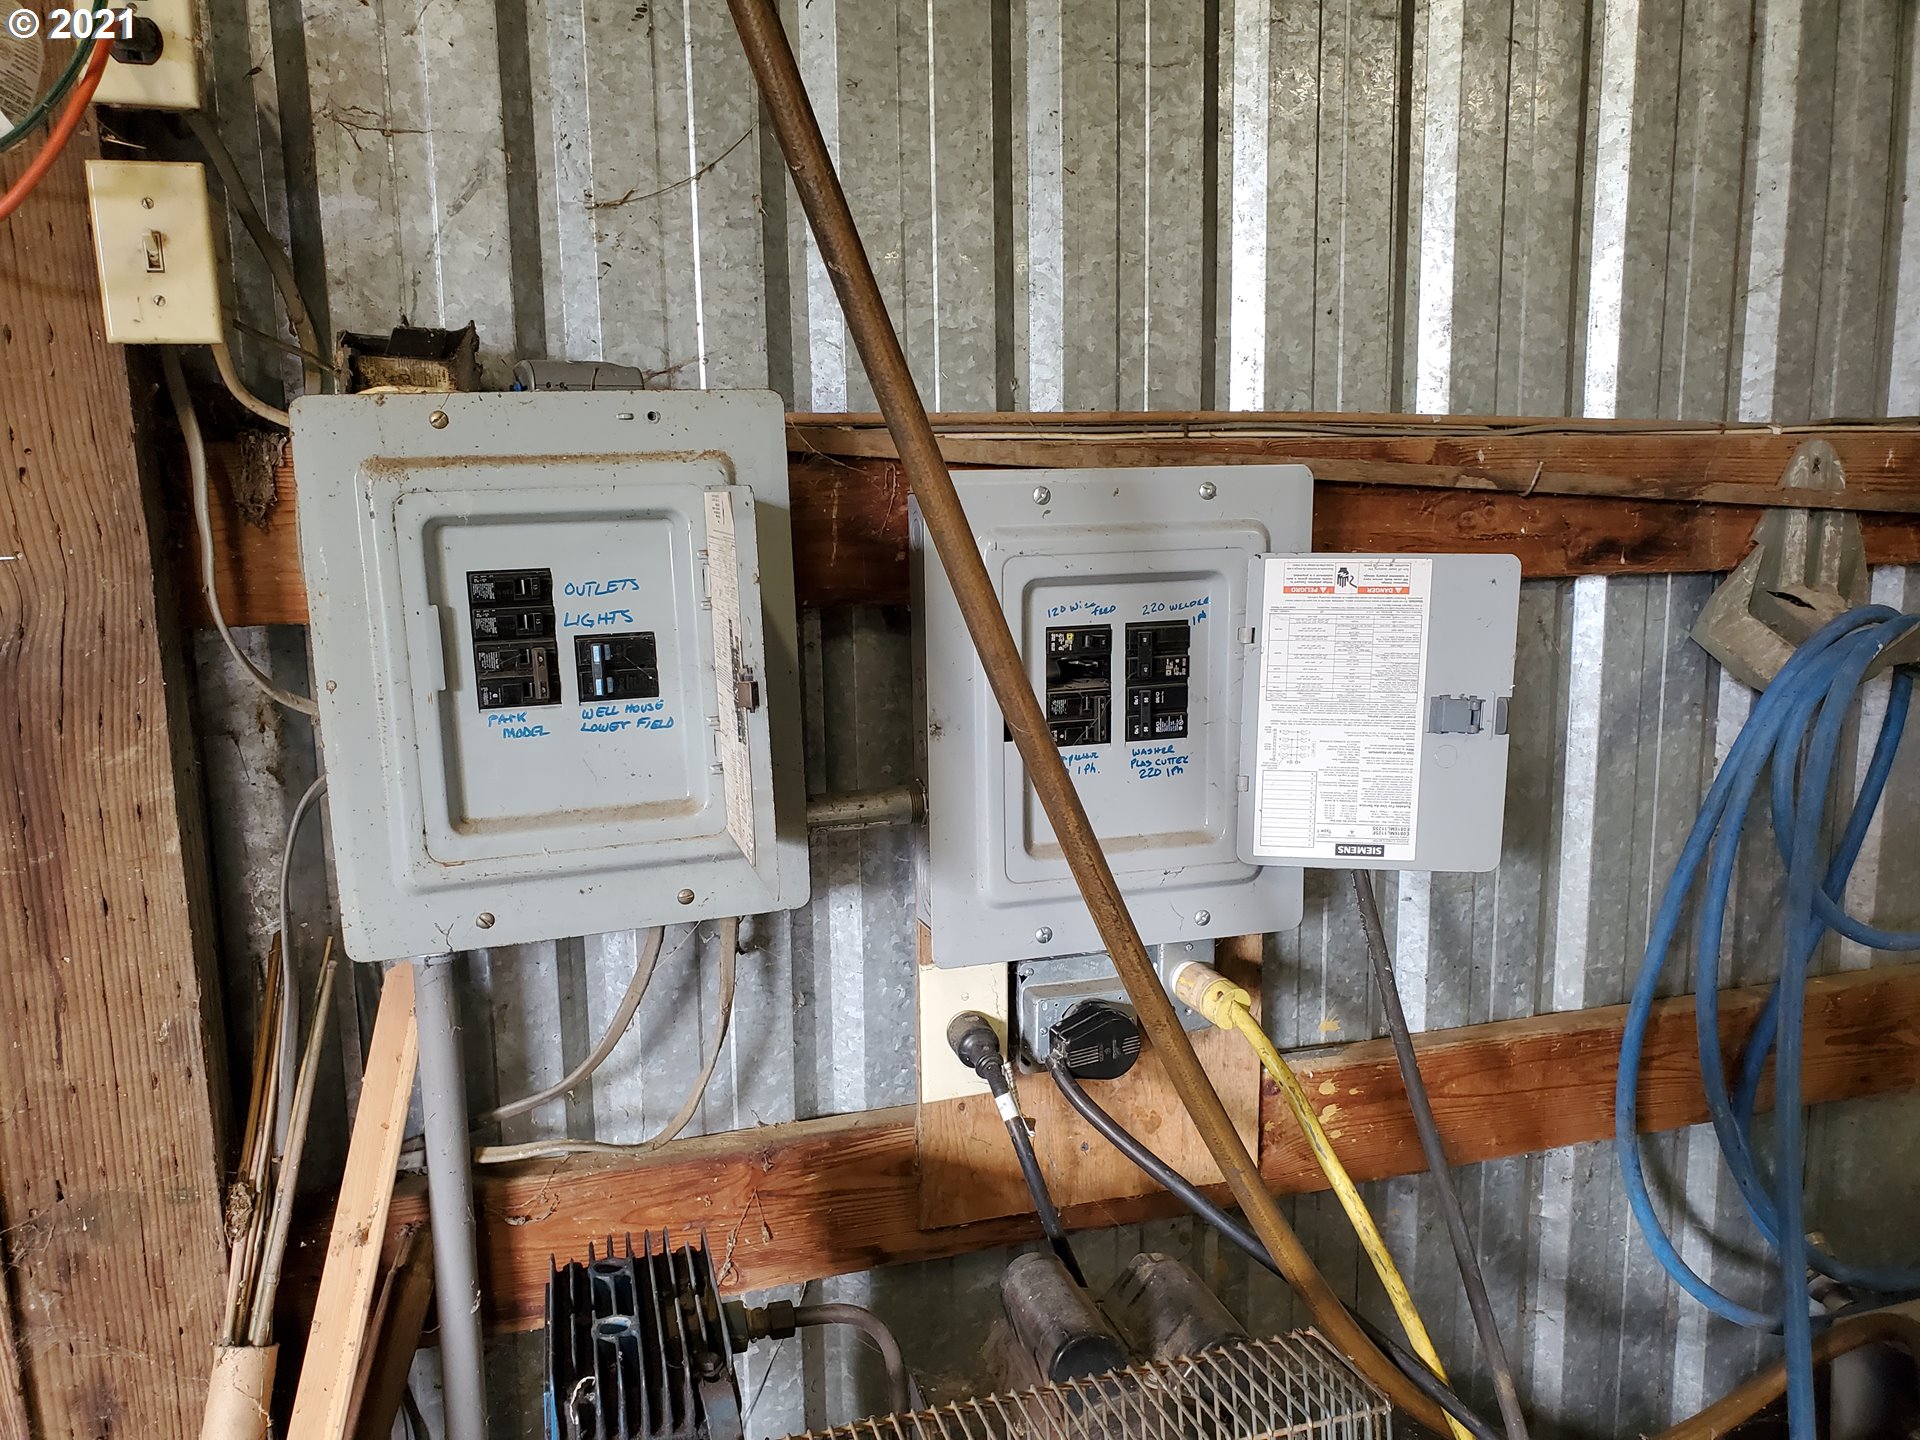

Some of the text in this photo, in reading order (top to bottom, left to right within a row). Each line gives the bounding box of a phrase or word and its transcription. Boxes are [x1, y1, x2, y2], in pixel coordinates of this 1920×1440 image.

[564, 578, 640, 598] OUTLETS
[1047, 604, 1067, 618] 120
[1142, 602, 1166, 616] 220
[563, 609, 634, 629] LIGHTS
[581, 699, 665, 720] WELL HOUSE
[636, 716, 675, 731] FIELD
[503, 725, 551, 739] MODEL
[1131, 745, 1175, 757] WASHER
[1130, 758, 1152, 769] PLAS
[1139, 767, 1162, 779] 220
[1337, 845, 1383, 856] SIEMENS
